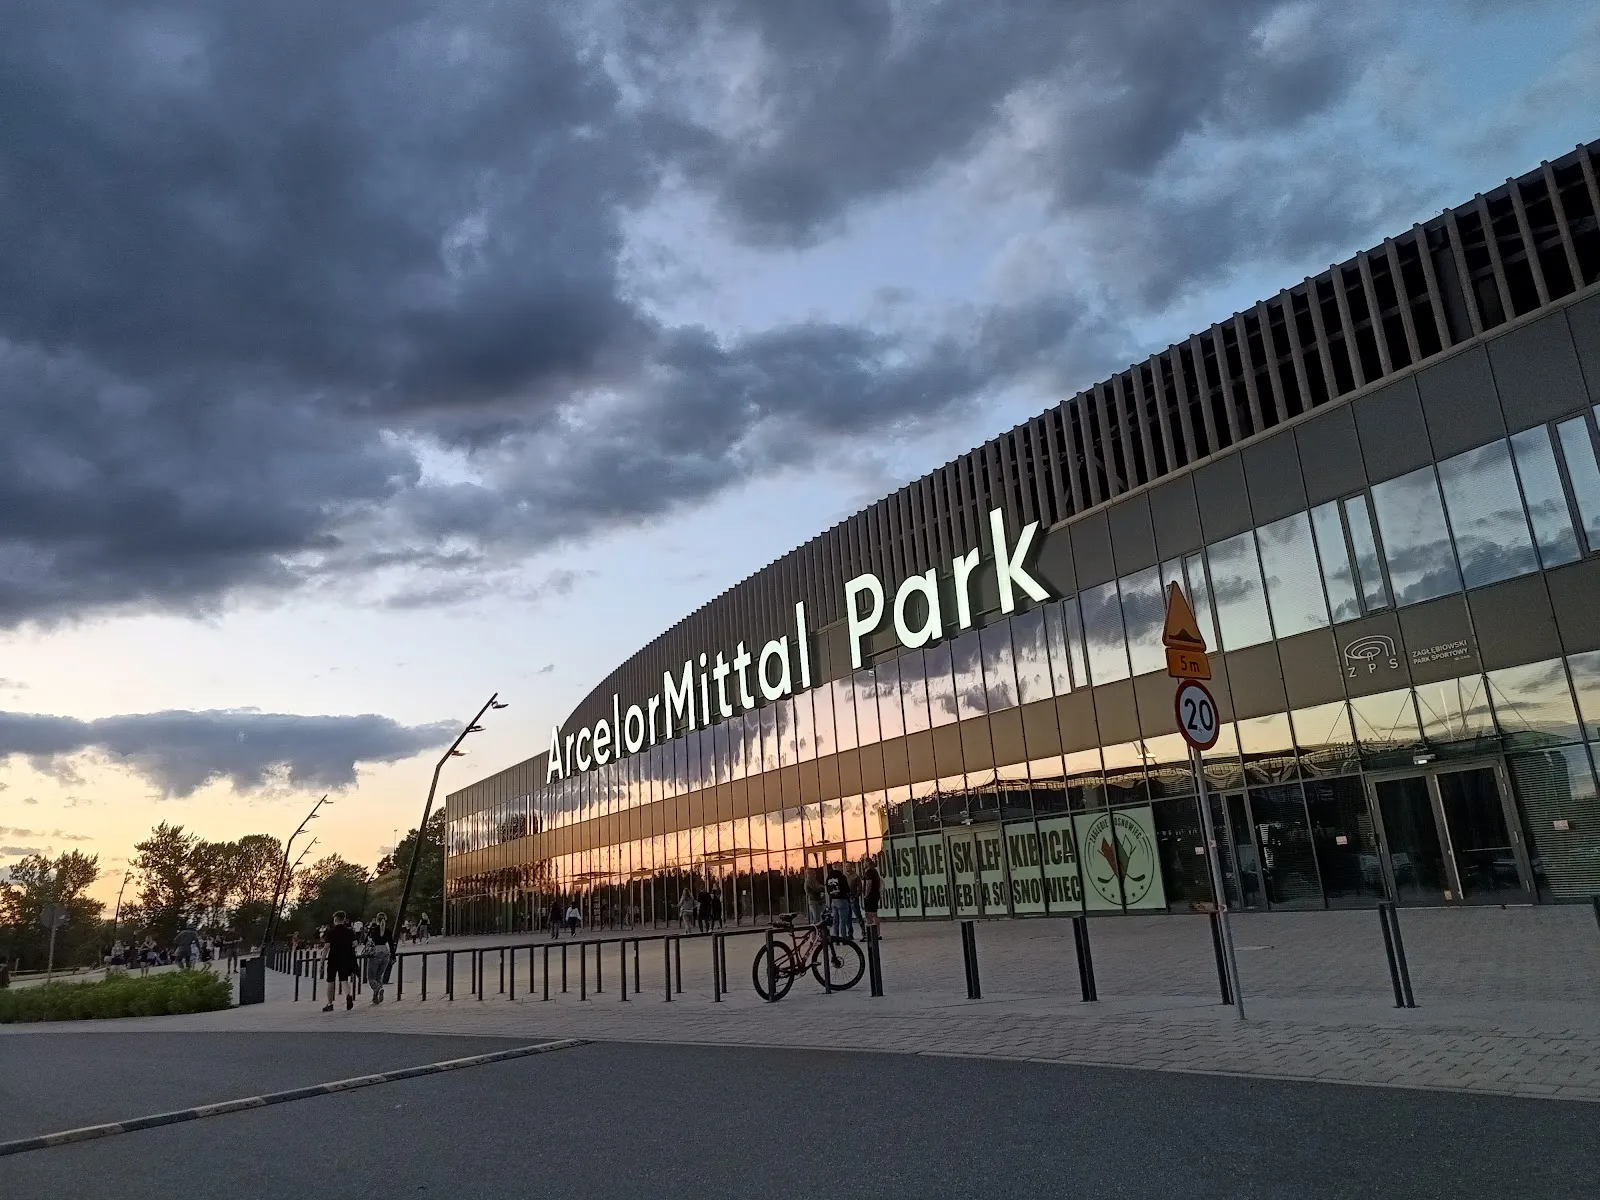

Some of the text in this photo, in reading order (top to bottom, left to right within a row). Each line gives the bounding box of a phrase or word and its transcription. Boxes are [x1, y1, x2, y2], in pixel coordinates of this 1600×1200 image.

[546, 507, 1051, 784] ArcelorMittal Park
[1413, 656, 1430, 664] PARK
[1431, 648, 1468, 661] SPORTOWY
[1180, 655, 1200, 673] 5 m
[1184, 697, 1214, 732] 20
[1112, 817, 1142, 840] OSNOWIEC
[874, 829, 1077, 879] OWSTAJE SKLEP KIBICA
[992, 875, 1081, 906] SOSNOWIEC
